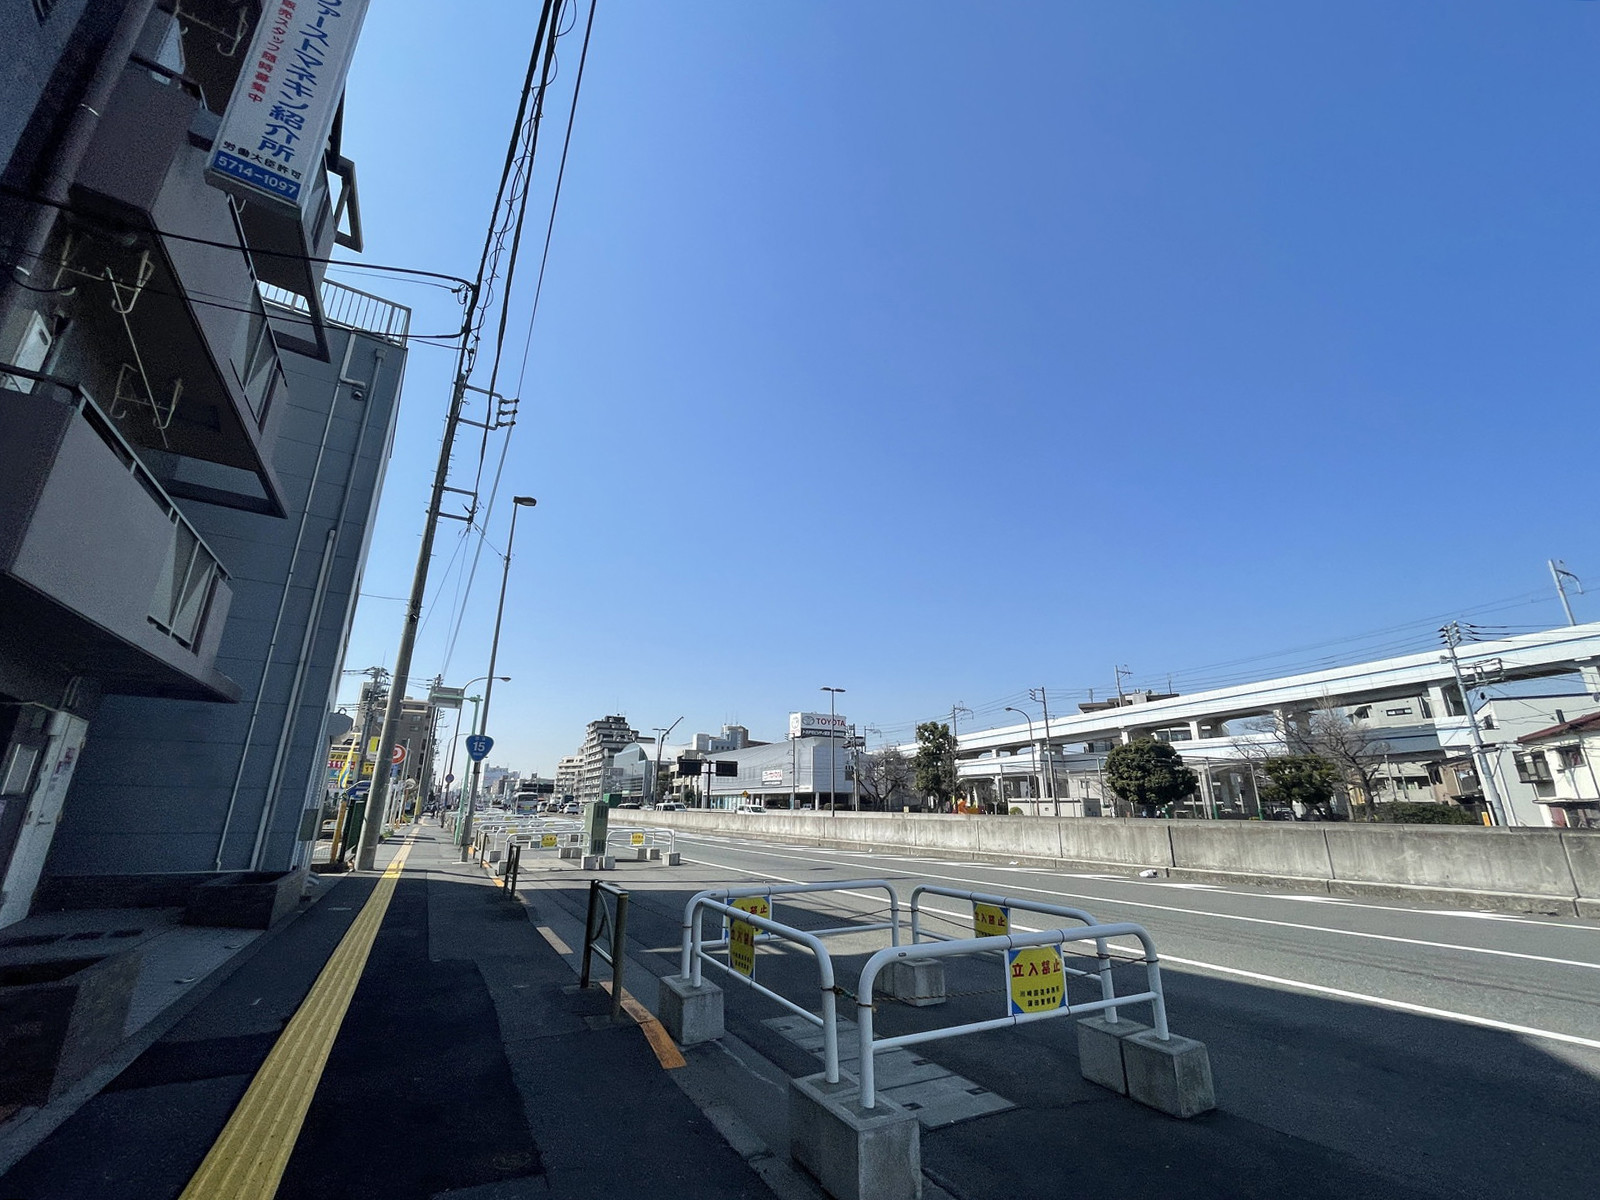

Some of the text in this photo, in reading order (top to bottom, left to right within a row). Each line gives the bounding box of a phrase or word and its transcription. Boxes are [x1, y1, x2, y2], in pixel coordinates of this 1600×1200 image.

[223, 141, 302, 180] 労働大臣許可
[218, 156, 297, 194] 5714-1097
[816, 717, 847, 727] TOYOTA
[473, 741, 486, 752] 15
[1012, 958, 1061, 978] 立入禁止
